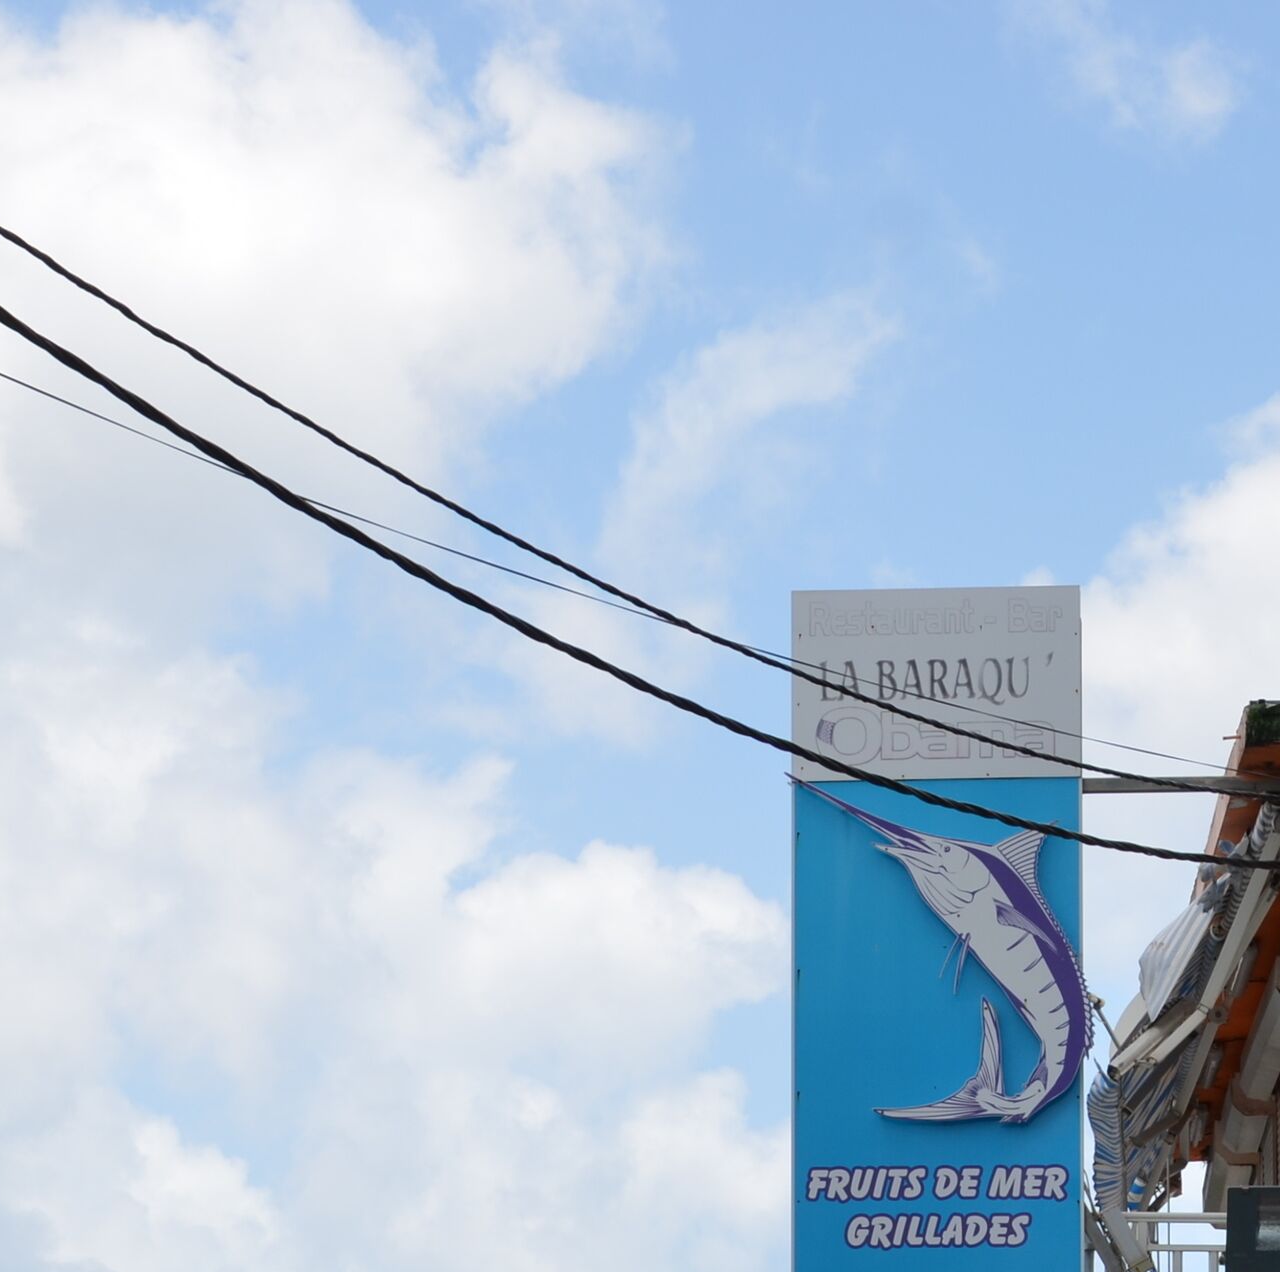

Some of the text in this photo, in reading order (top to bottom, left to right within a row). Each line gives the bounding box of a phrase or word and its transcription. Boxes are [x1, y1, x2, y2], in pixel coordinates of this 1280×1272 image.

[808, 599, 975, 637] Restaurant
[1007, 597, 1063, 633] Bar
[820, 660, 860, 702] LA
[815, 706, 1057, 766] Obama
[806, 1164, 1069, 1203] FRUITS DE MER
[844, 1212, 1032, 1250] GRILLADES
